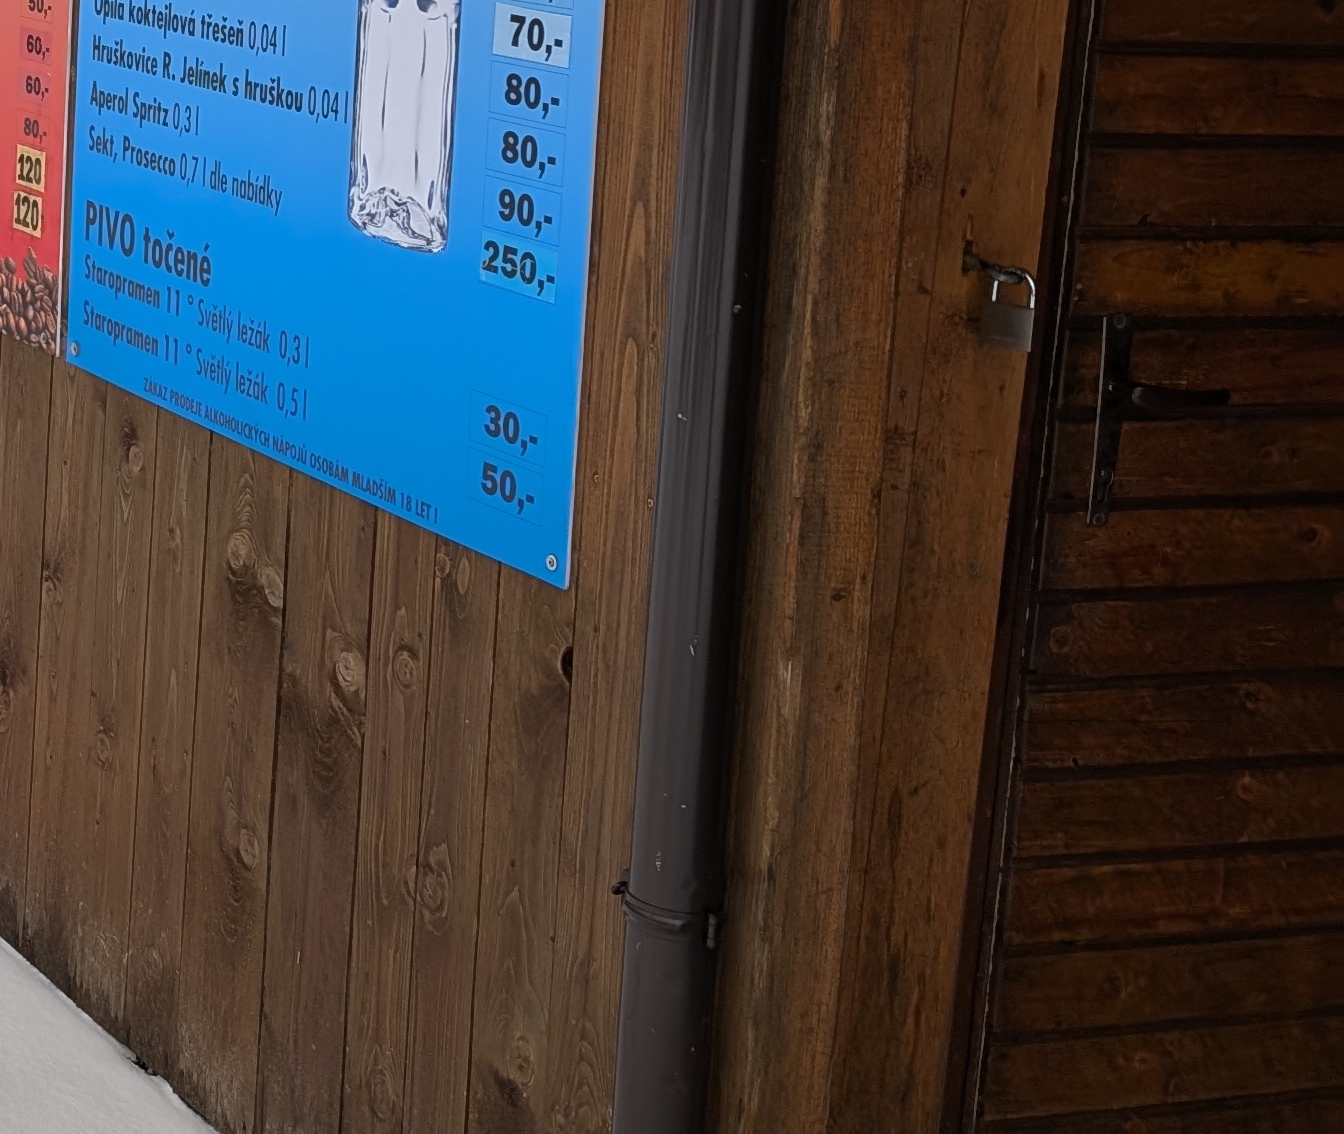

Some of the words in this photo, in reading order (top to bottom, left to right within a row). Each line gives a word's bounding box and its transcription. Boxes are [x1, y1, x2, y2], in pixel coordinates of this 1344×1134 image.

[200, 13, 244, 47] třešeň
[248, 21, 278, 57] 0,04
[509, 13, 563, 61] 70,-
[504, 72, 560, 120] 80,-
[17, 152, 42, 186] 120
[498, 187, 553, 238] 90,-
[84, 199, 135, 257] PIVO
[142, 226, 211, 287] točené
[482, 240, 556, 297] 250,-
[84, 254, 160, 309] Staropramen
[166, 286, 181, 317] 11
[197, 298, 233, 345] Světlý
[237, 310, 271, 353] ležák
[279, 330, 301, 367] 0,3
[143, 376, 167, 401] ZÁKAZ
[170, 389, 203, 418] PRODEJE
[204, 405, 270, 448] ALKOHOLICKÝCH
[272, 435, 307, 465] NÁPOJŮ
[309, 453, 349, 484] OSOBÁM
[352, 471, 397, 506] MLADŠÍM
[400, 492, 412, 513] 18
[415, 500, 432, 521] LET
[483, 404, 538, 457] 30,-
[480, 462, 535, 516] 50,-
